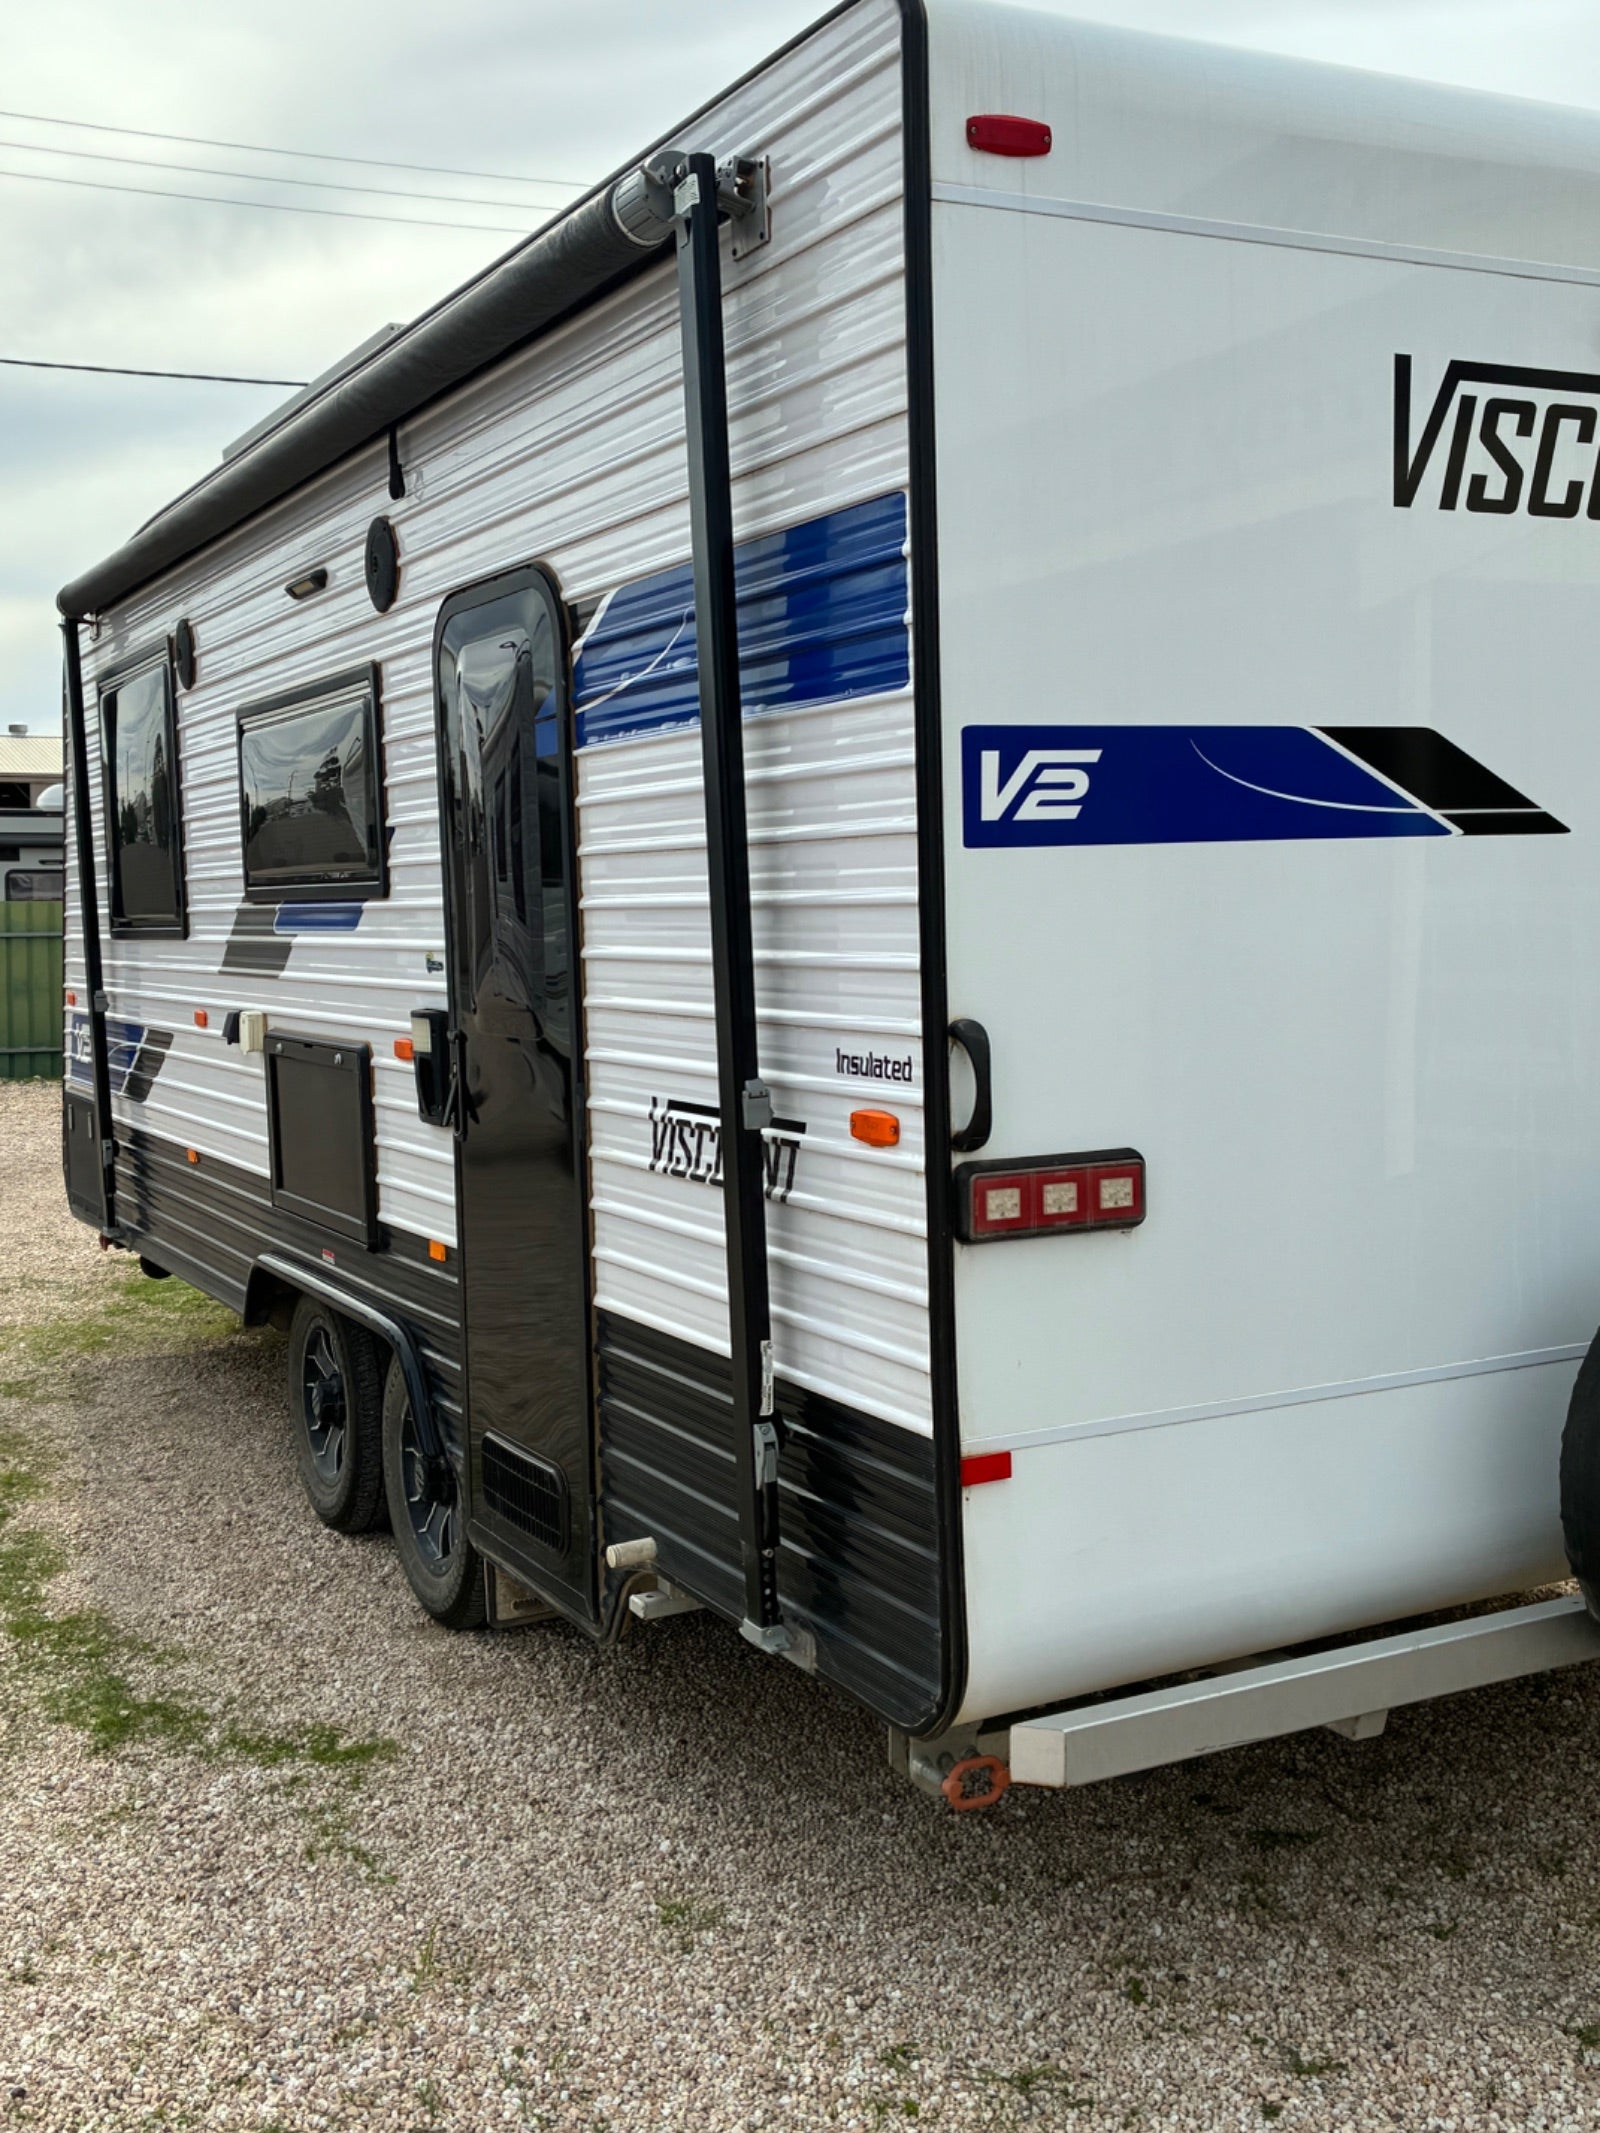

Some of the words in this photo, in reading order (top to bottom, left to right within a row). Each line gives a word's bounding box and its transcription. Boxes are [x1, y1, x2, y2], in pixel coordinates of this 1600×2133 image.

[1393, 353, 1600, 521] VISC
[981, 749, 1103, 821] V2
[836, 1047, 912, 1082] Insulated
[649, 1096, 807, 1203] VISCNT
